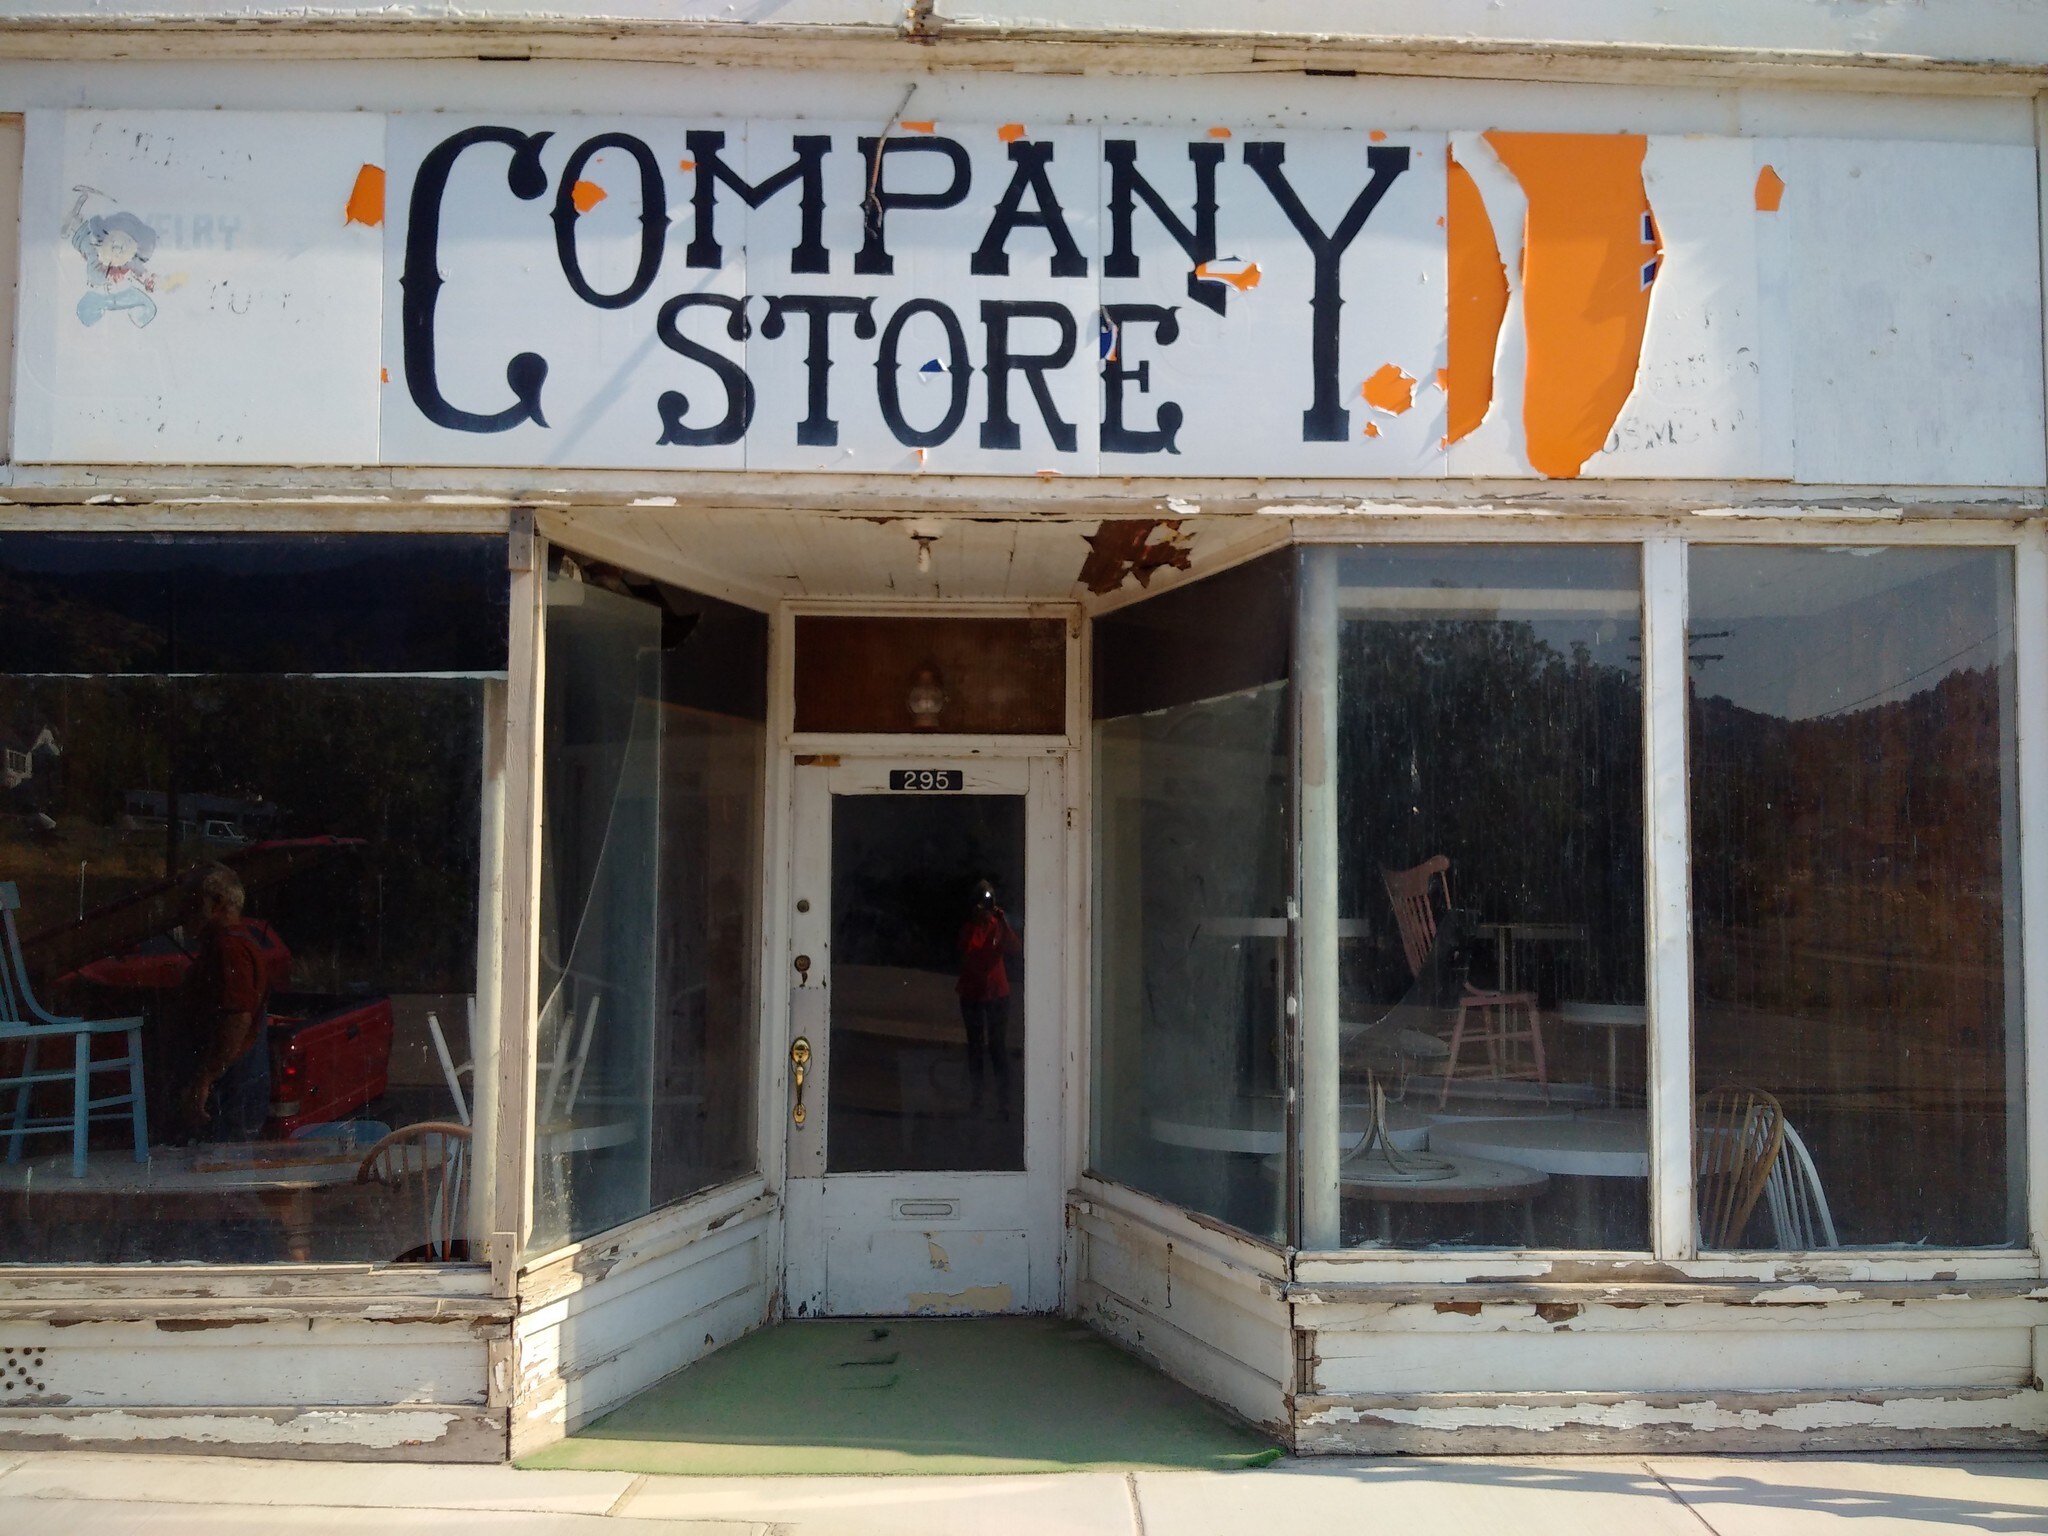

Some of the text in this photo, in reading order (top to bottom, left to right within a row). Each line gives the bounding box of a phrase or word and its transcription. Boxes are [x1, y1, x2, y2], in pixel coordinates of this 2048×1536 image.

[146, 212, 241, 251] ELRY
[399, 125, 1410, 442] COMPANY
[656, 292, 1183, 455] STORE
[904, 771, 949, 790] 295
